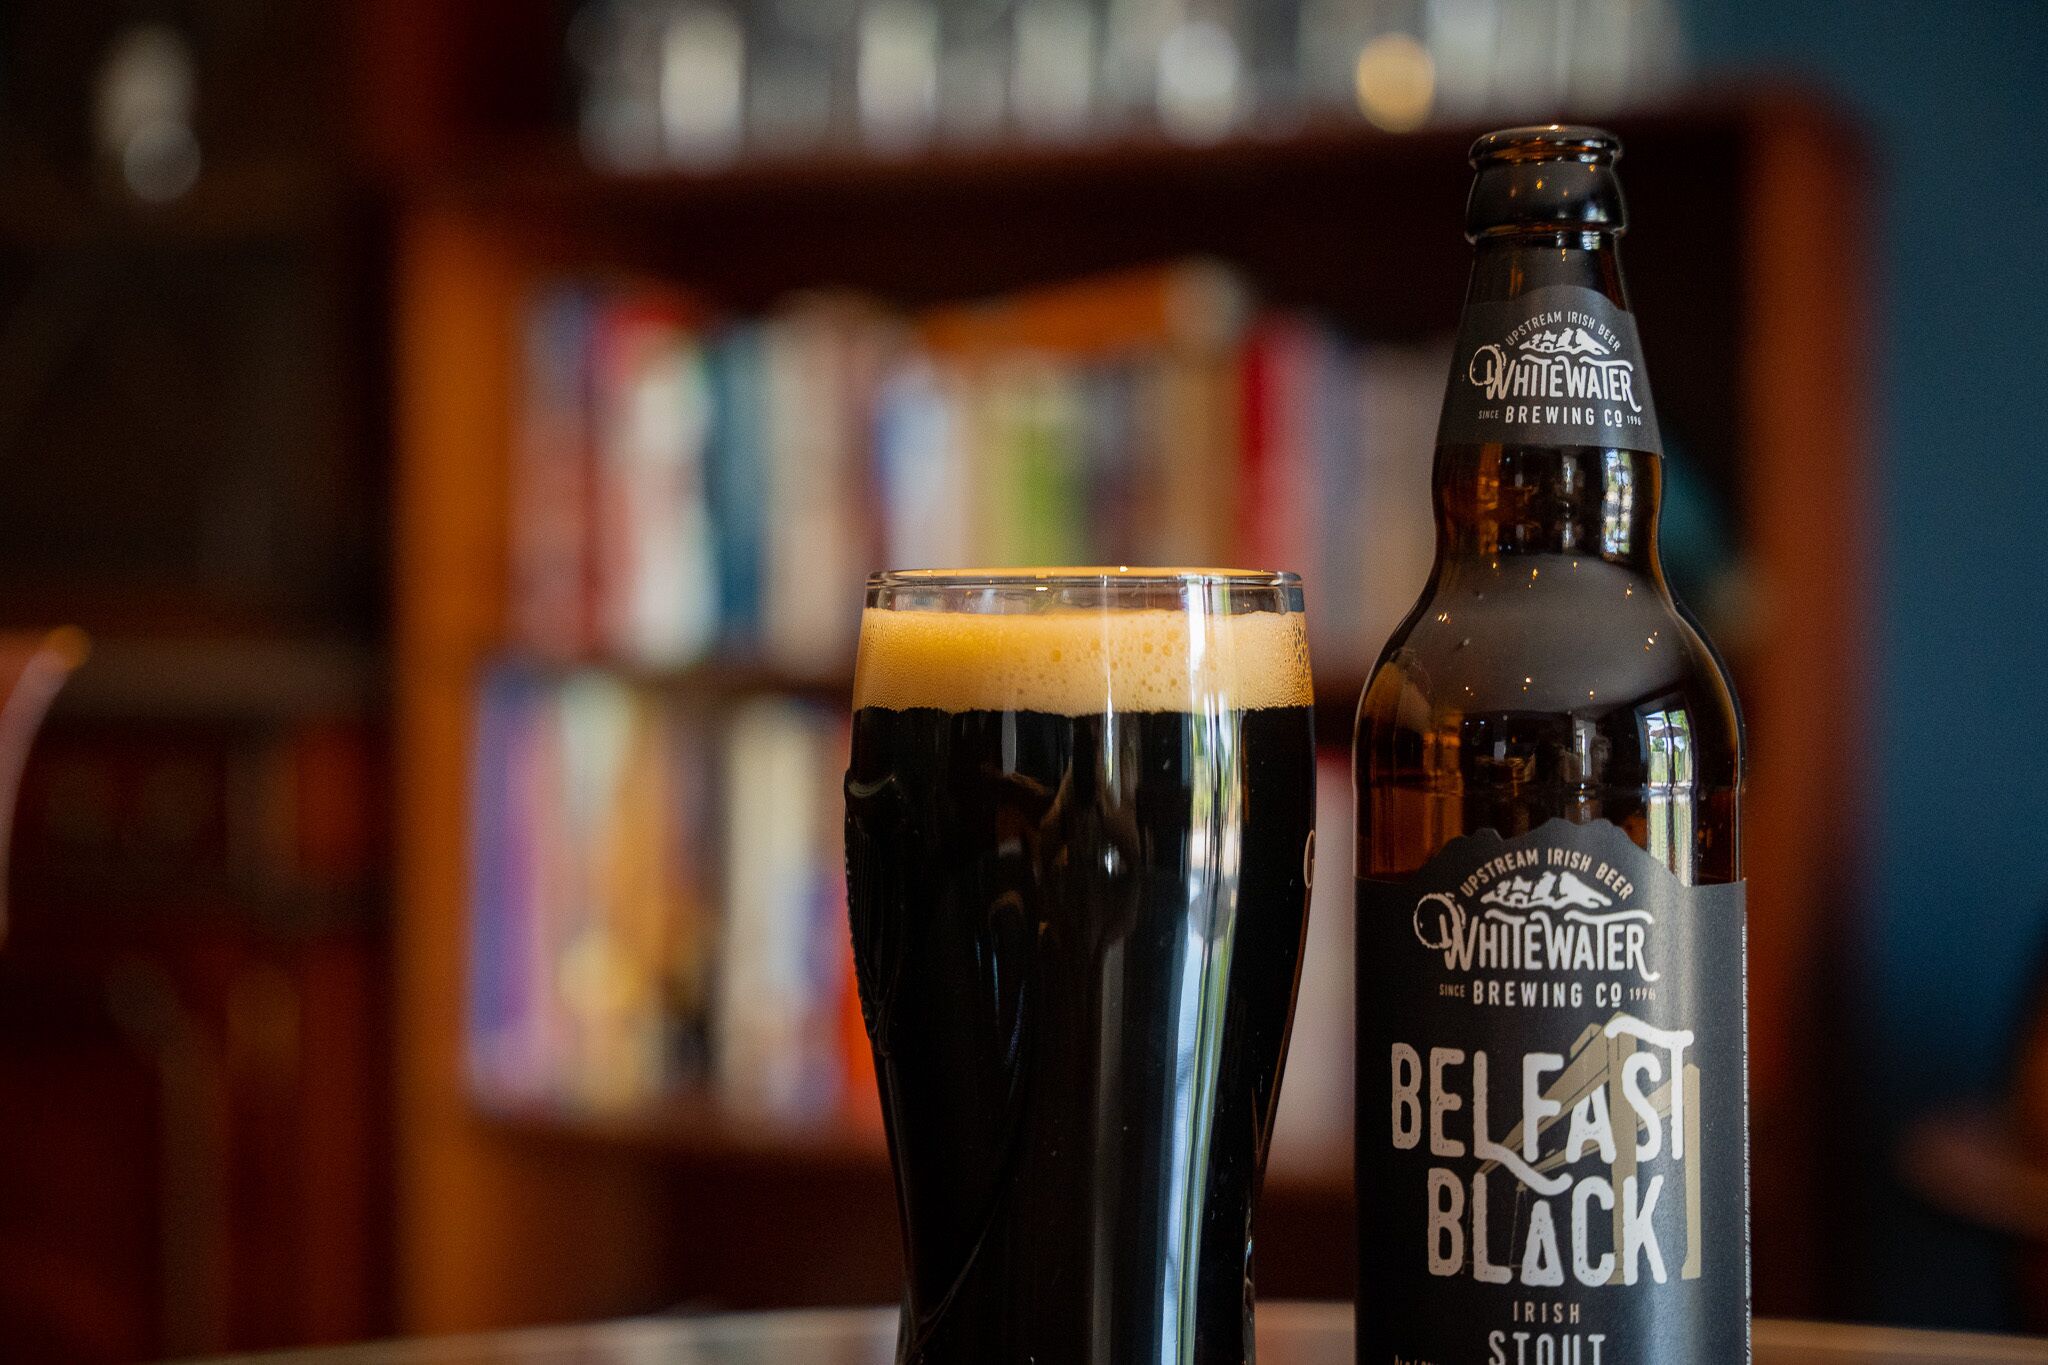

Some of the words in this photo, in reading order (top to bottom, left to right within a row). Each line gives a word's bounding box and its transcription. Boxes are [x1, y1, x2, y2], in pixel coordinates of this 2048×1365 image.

[1505, 311, 1562, 346] UPSTREAM
[1567, 311, 1596, 329] IRISH
[1598, 324, 1621, 351] BEER
[1469, 344, 1642, 412] WHITEWATER
[1478, 410, 1499, 420] SINCE
[1505, 405, 1595, 426] BREWING
[1460, 847, 1540, 898] UPSTREAM
[1547, 847, 1593, 873] IRISH
[1595, 862, 1635, 901] BEER
[1413, 893, 1660, 982] WHITEWATER
[1439, 983, 1465, 997] SINCE
[1473, 980, 1583, 1008] BREWING
[1391, 1016, 1694, 1195] BELFAST
[1427, 1167, 1668, 1287] BLACK
[1513, 1301, 1580, 1324] IRISH
[1488, 1330, 1606, 1365] STOUT
